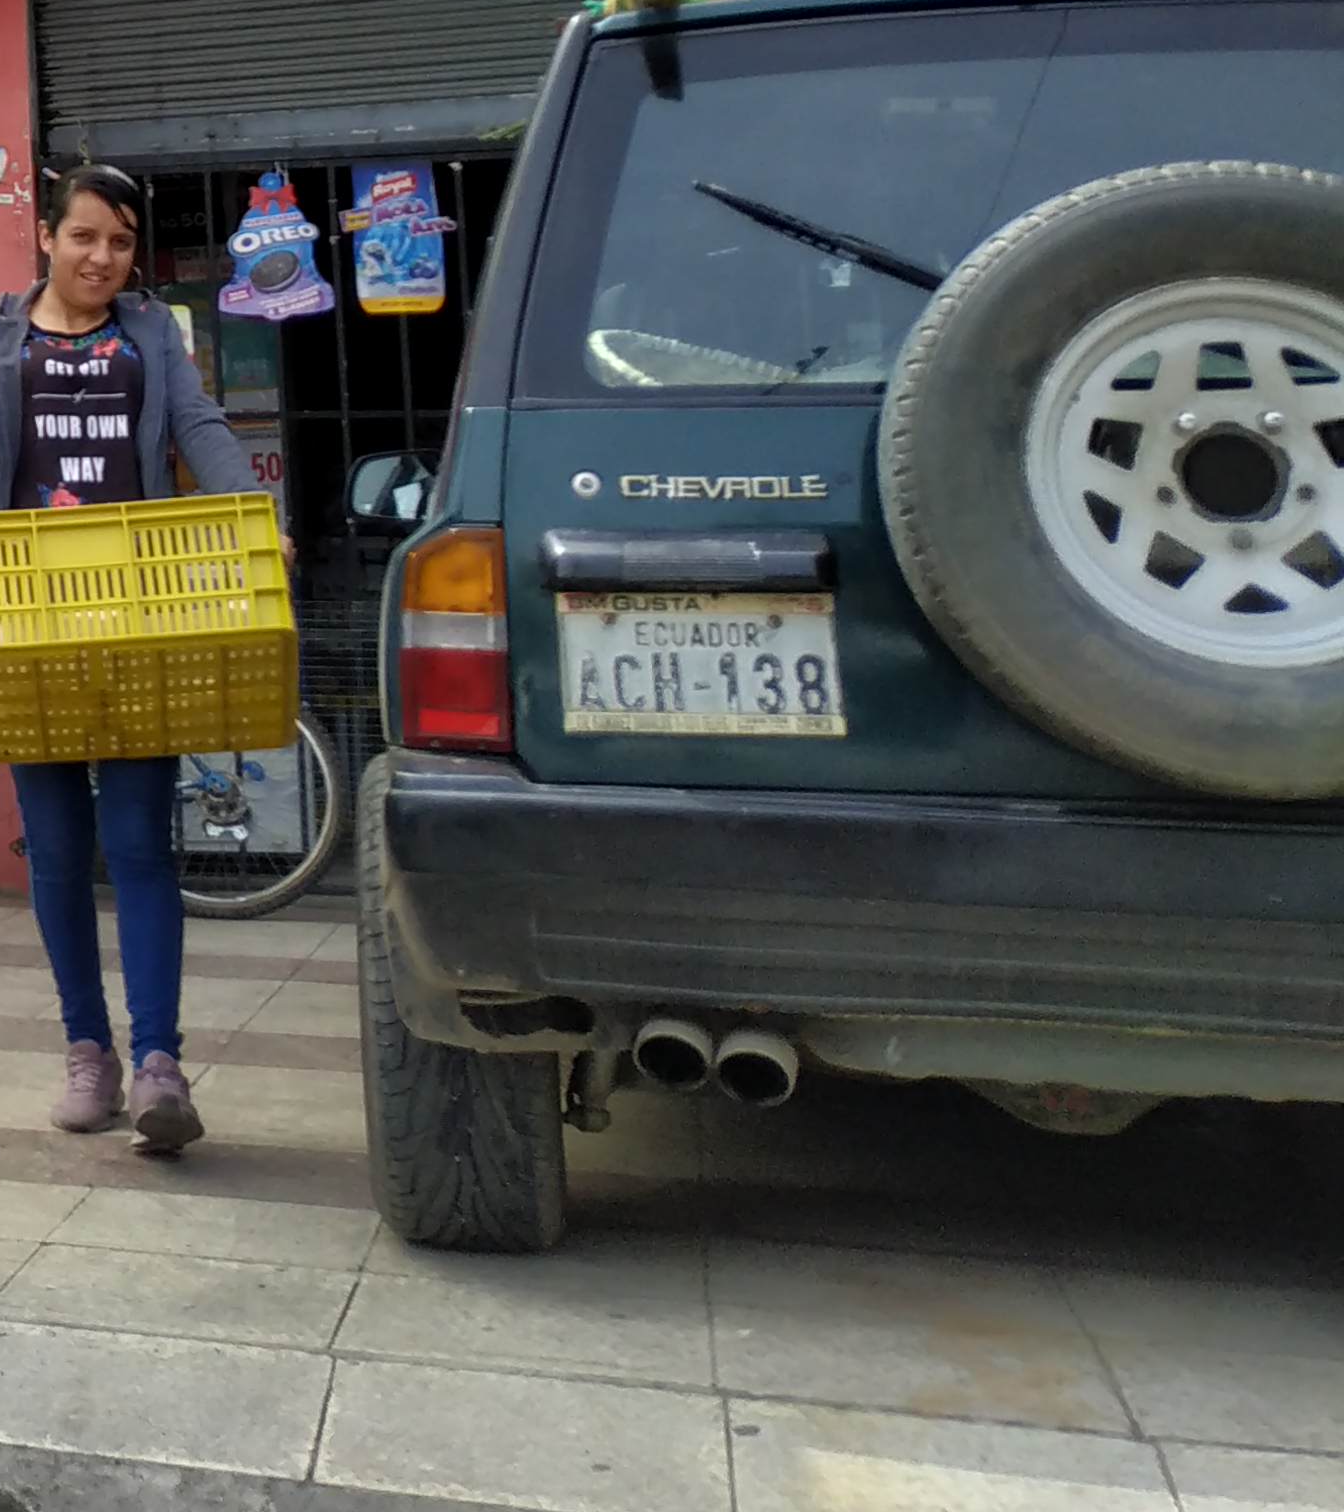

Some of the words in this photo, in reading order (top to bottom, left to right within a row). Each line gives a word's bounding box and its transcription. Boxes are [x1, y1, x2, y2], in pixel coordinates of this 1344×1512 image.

[231, 224, 314, 255] OREO
[44, 358, 74, 375] GET
[34, 414, 82, 439] YOUR
[86, 414, 129, 439] OWN
[59, 456, 106, 483] WAY
[634, 621, 761, 648] ECUADOR
[579, 650, 829, 715] ACH-138
